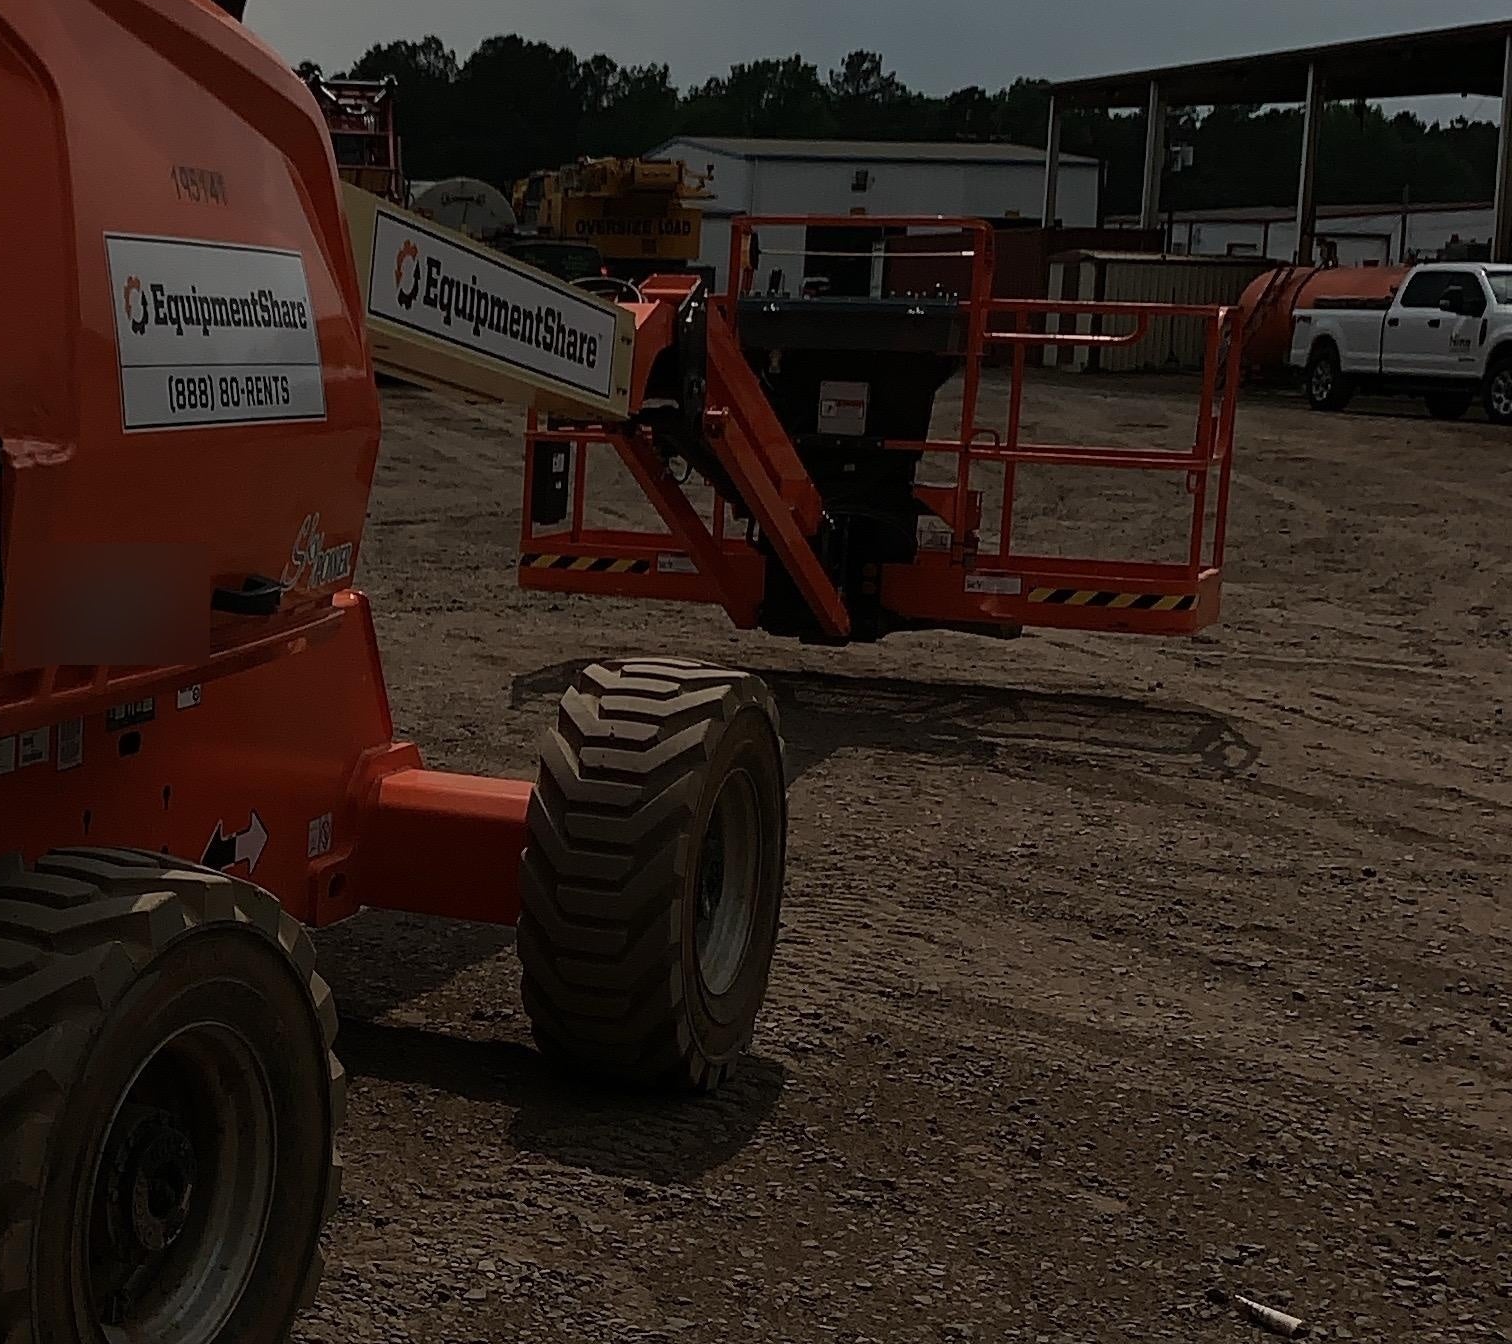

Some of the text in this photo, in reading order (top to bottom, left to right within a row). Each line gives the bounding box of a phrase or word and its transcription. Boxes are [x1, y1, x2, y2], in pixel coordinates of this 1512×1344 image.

[659, 218, 692, 236] LOAD
[149, 283, 308, 337] EquipmentShare
[422, 256, 598, 370] EquipmentShare
[168, 374, 290, 413] (888) 80-RENTS
